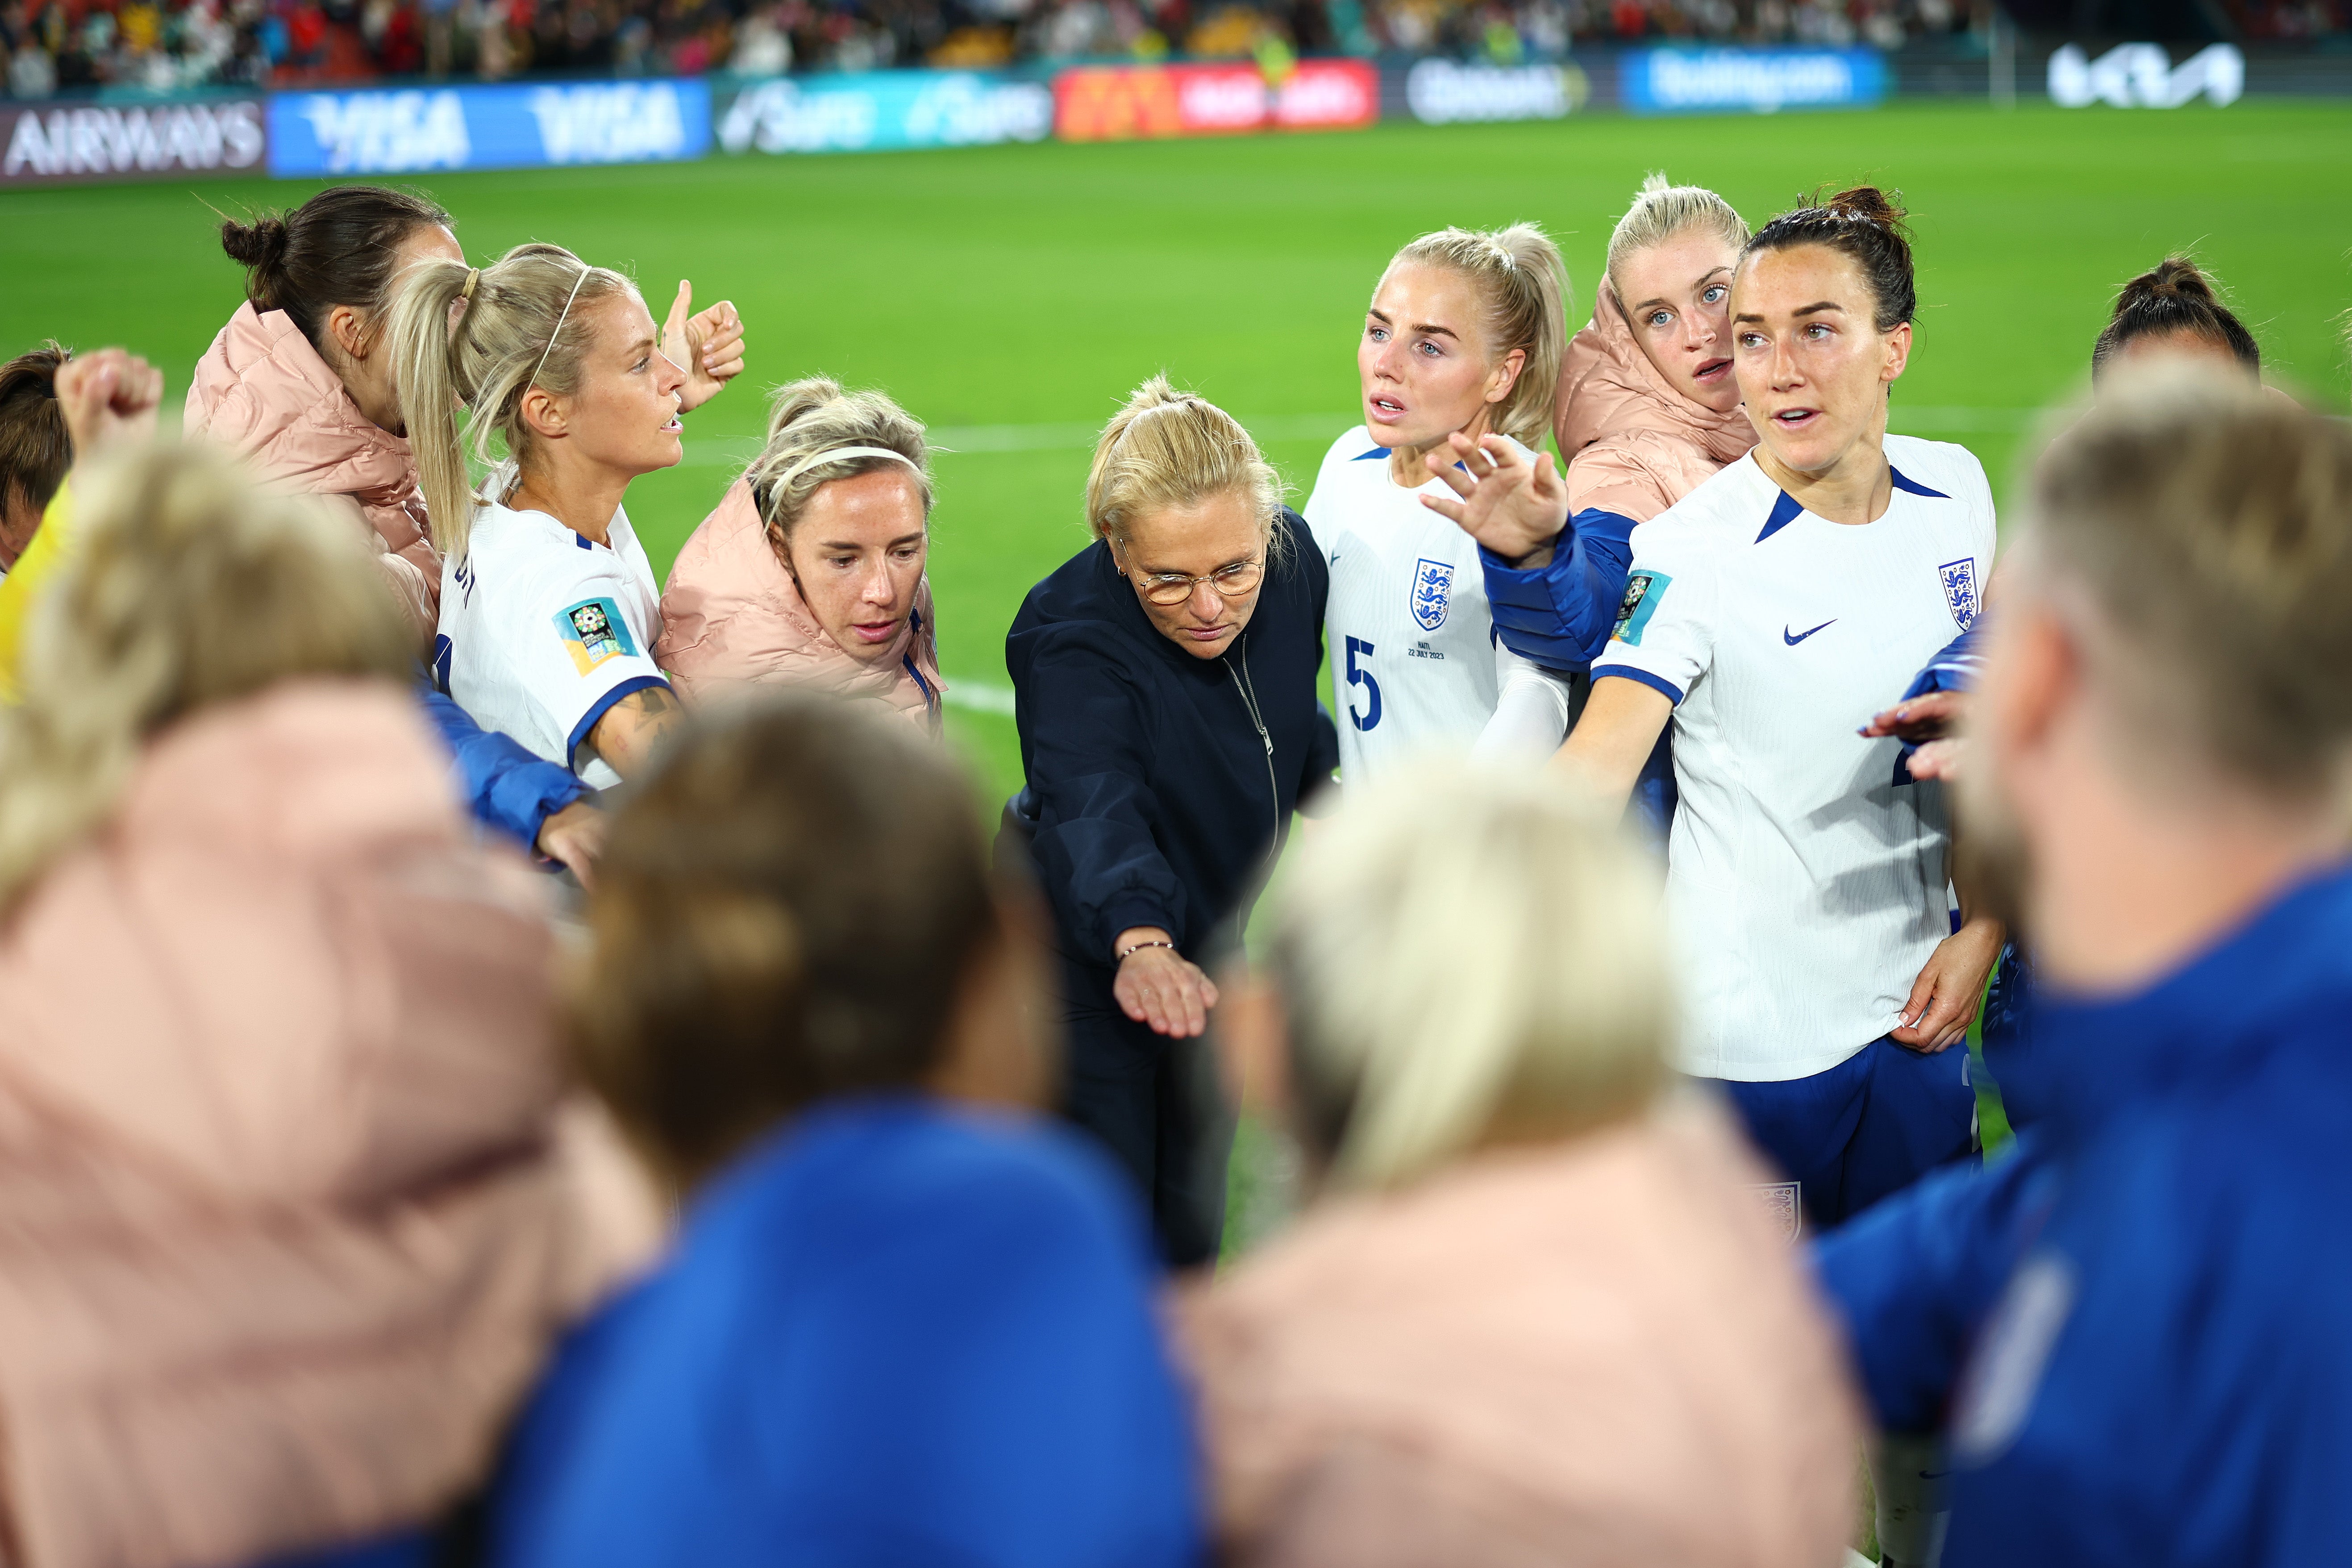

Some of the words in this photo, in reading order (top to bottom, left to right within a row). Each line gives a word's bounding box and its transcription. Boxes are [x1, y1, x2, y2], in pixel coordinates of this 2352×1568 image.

[4, 101, 263, 176] AIRWAYS
[299, 92, 470, 174] VISA
[526, 82, 684, 163] VISA
[1416, 650, 1428, 658] JULY
[1418, 641, 1430, 650] HAITI
[1345, 635, 1382, 732] 5
